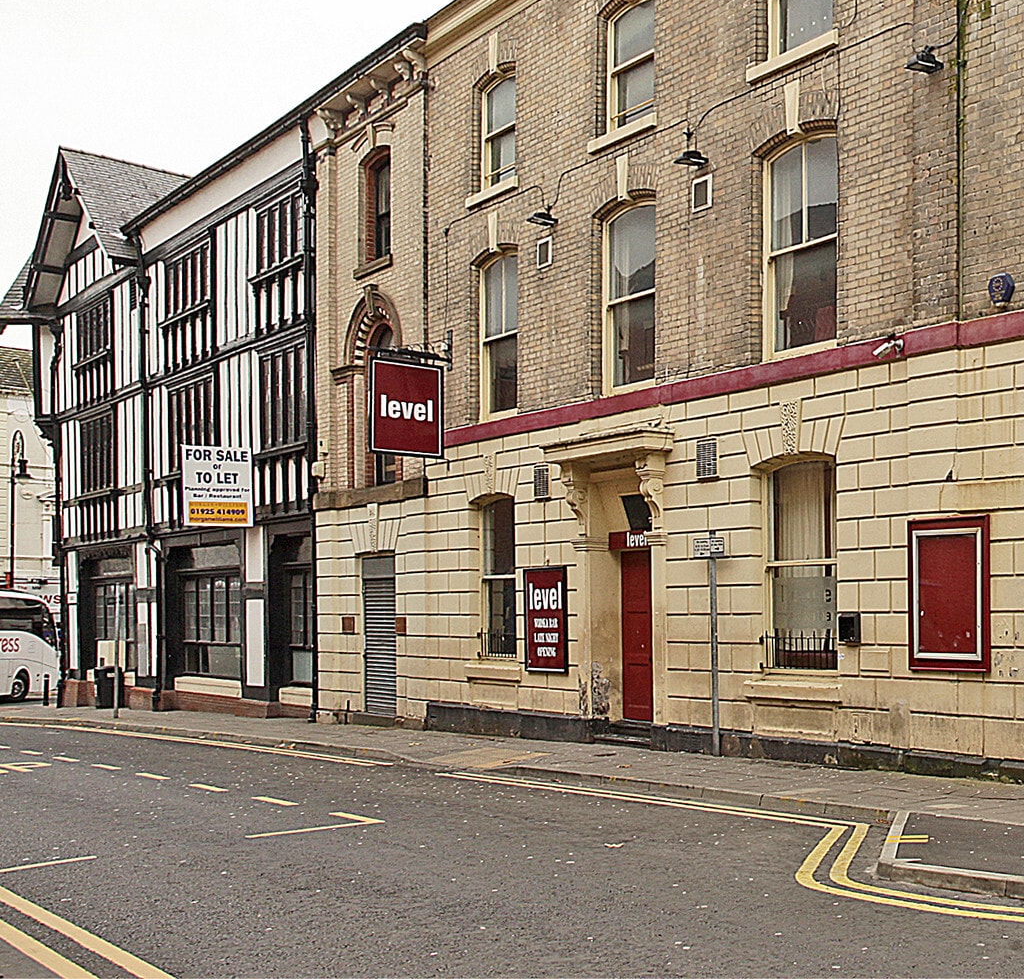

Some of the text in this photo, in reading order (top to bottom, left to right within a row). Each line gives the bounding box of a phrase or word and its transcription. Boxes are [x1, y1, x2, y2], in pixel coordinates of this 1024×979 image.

[380, 394, 434, 422] level
[185, 448, 249, 462] FOR SALE
[195, 471, 239, 485] TO LET
[528, 581, 563, 611] level
[537, 646, 557, 657] OPENING
